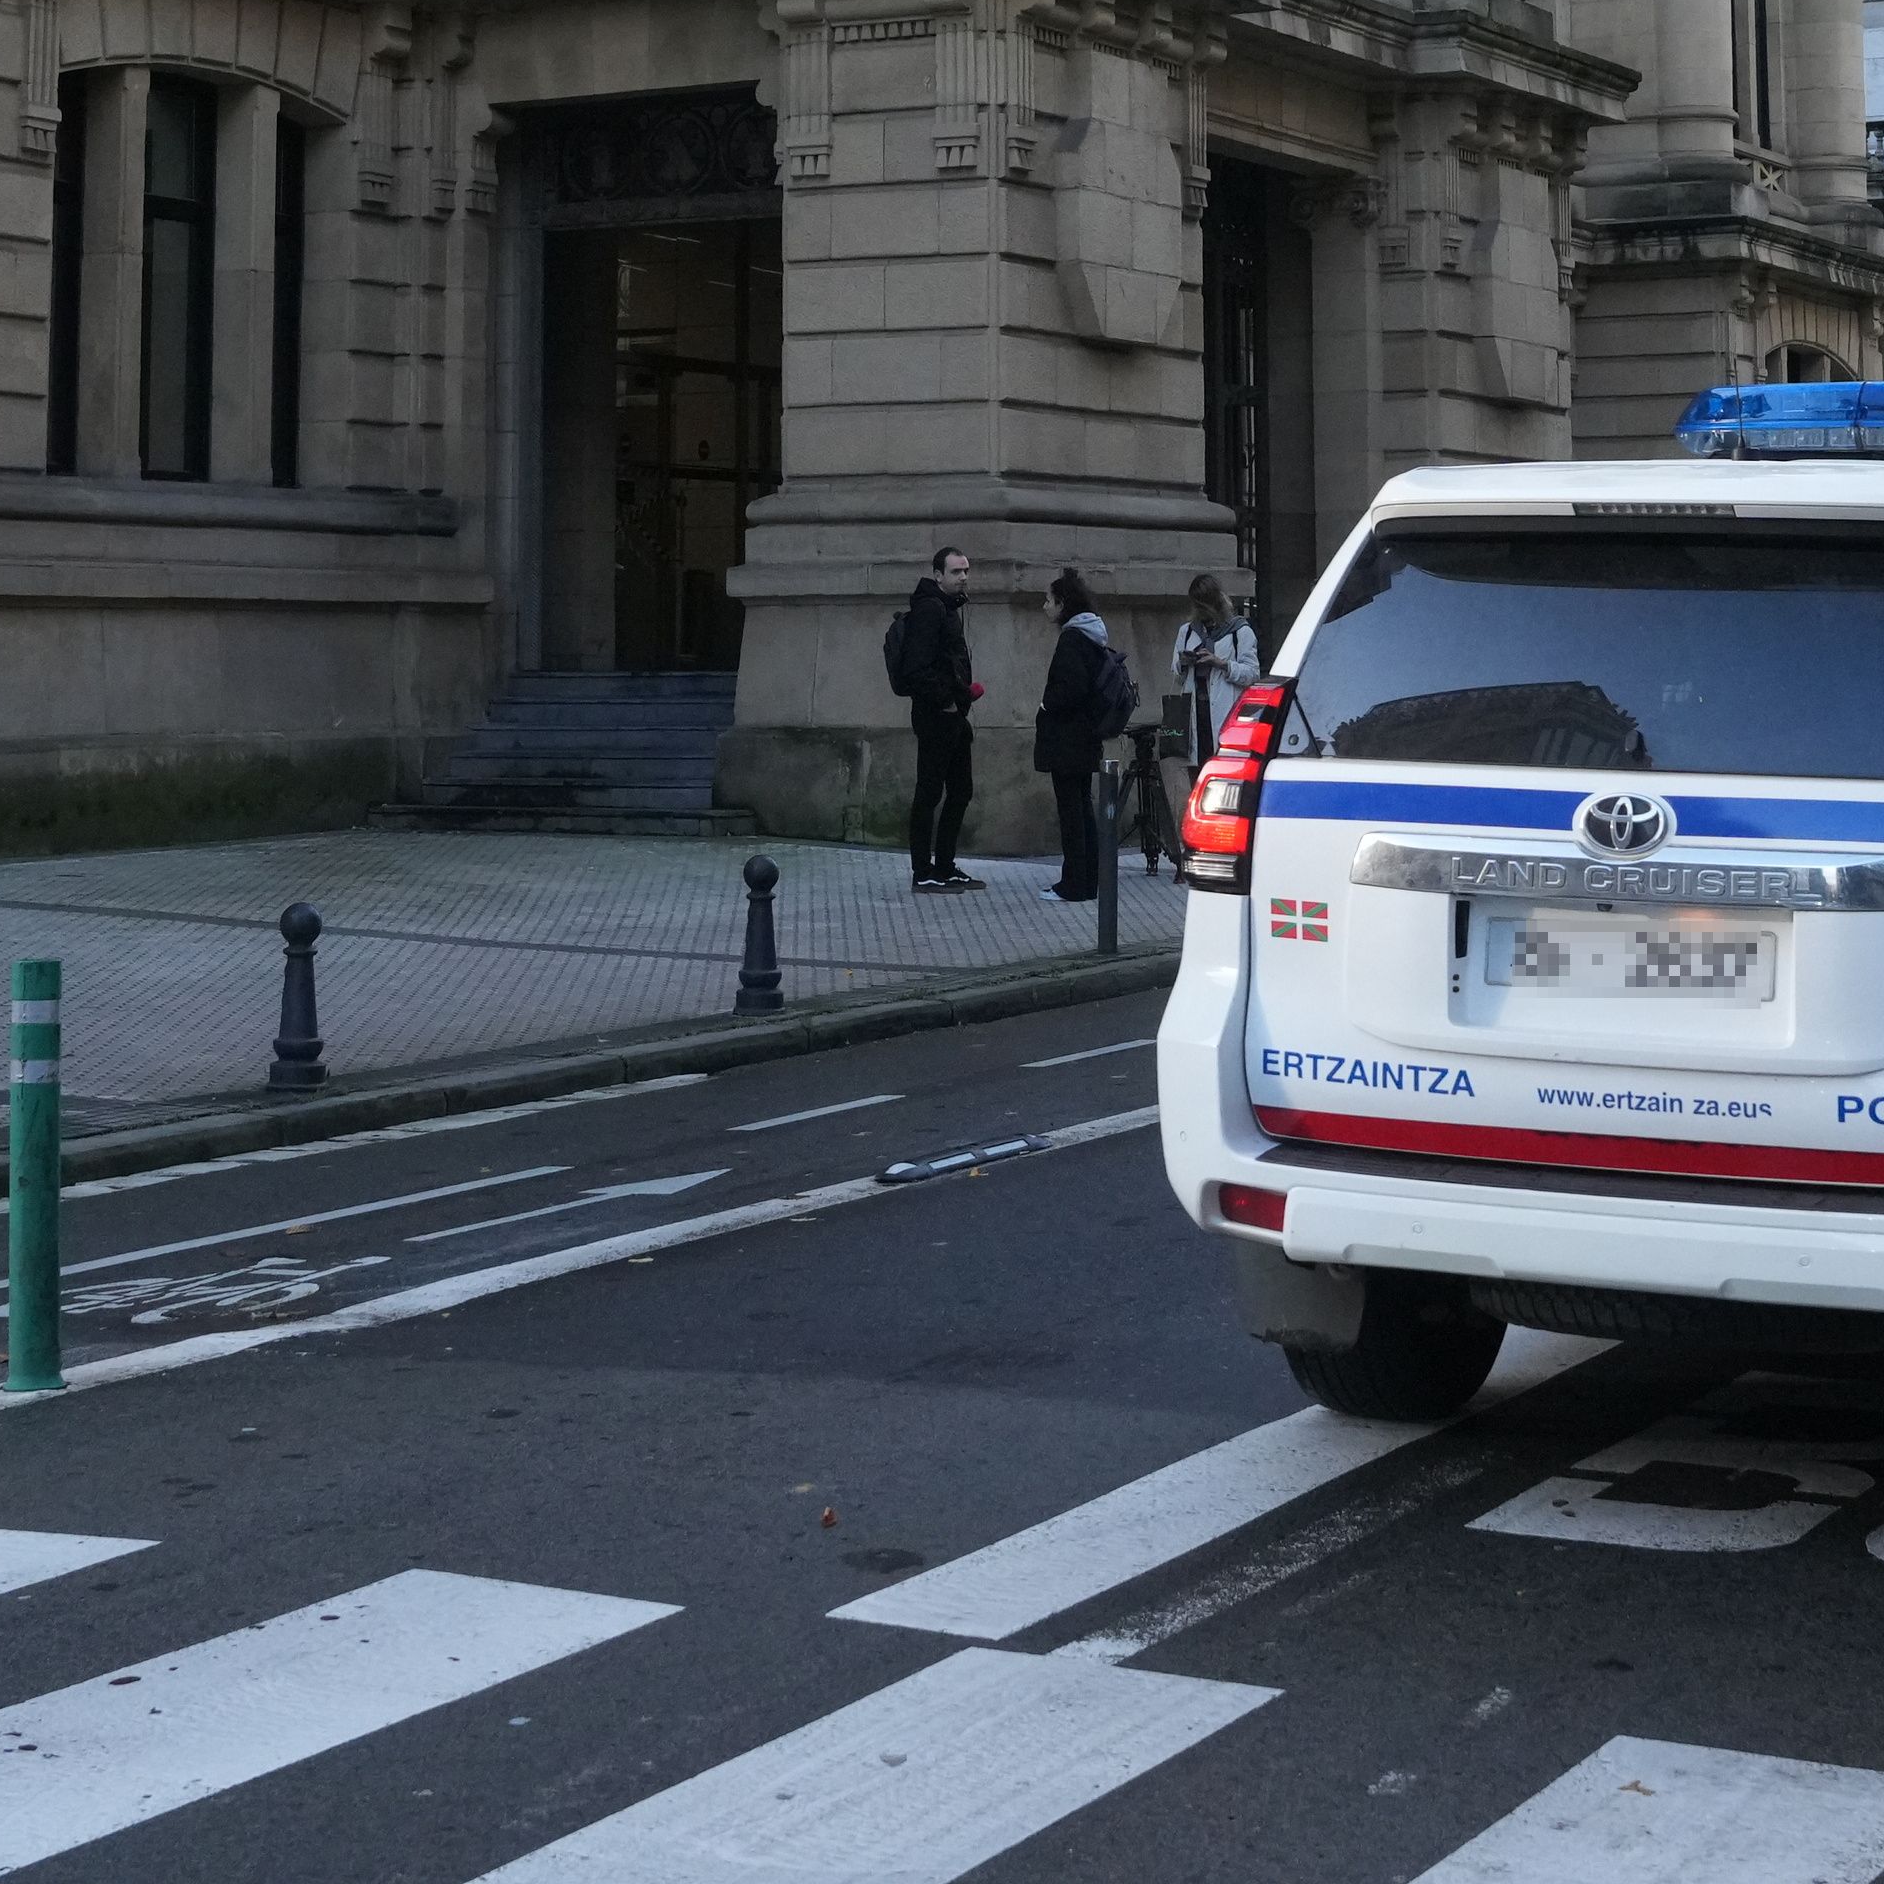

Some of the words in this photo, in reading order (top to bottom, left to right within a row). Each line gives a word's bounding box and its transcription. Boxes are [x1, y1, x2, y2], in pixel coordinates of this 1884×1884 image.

[1451, 856, 1567, 890] LAND
[1583, 863, 1794, 898] CRUISER
[1262, 1048, 1476, 1098] ERTZAINTZA
